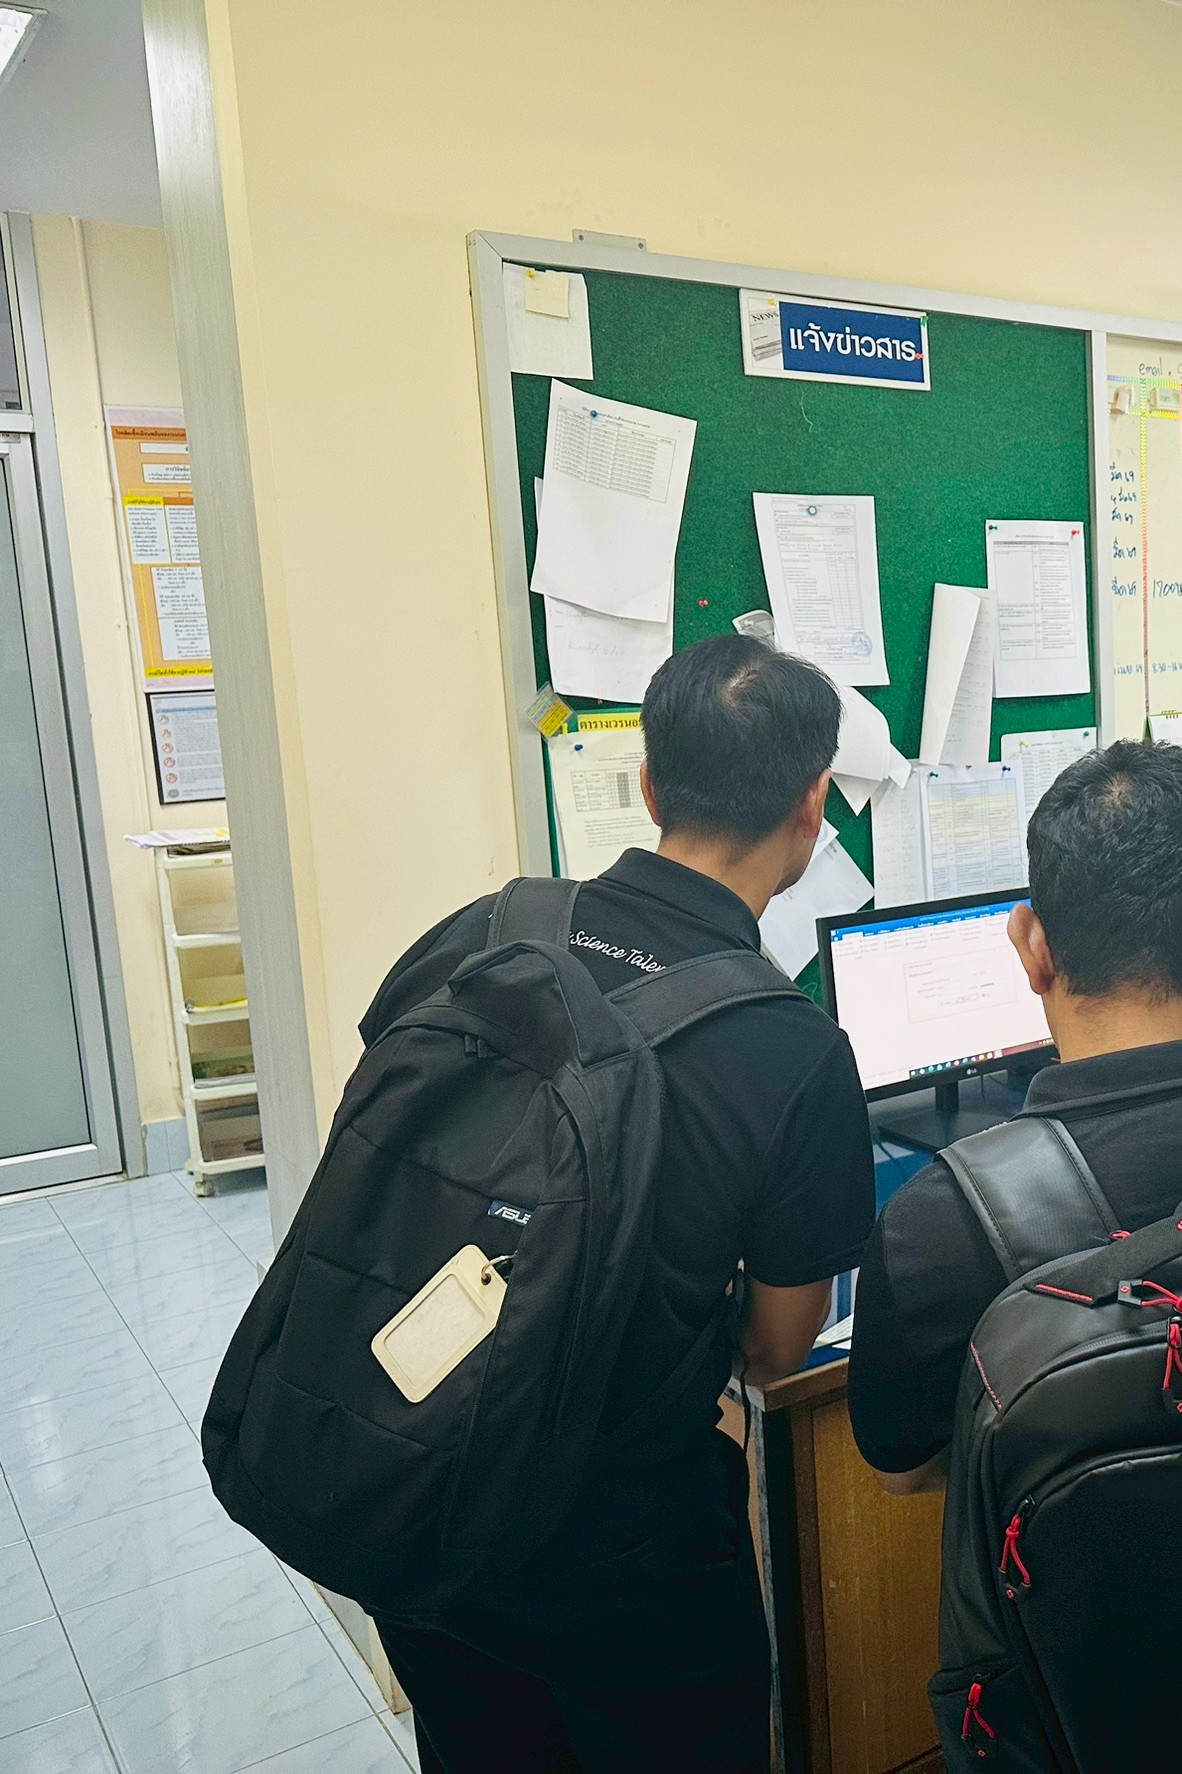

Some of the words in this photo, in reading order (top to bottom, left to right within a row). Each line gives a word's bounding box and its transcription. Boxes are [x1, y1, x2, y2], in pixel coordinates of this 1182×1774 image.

[789, 322, 917, 362] แจ้งข่าวสาร
[570, 930, 627, 959] Science
